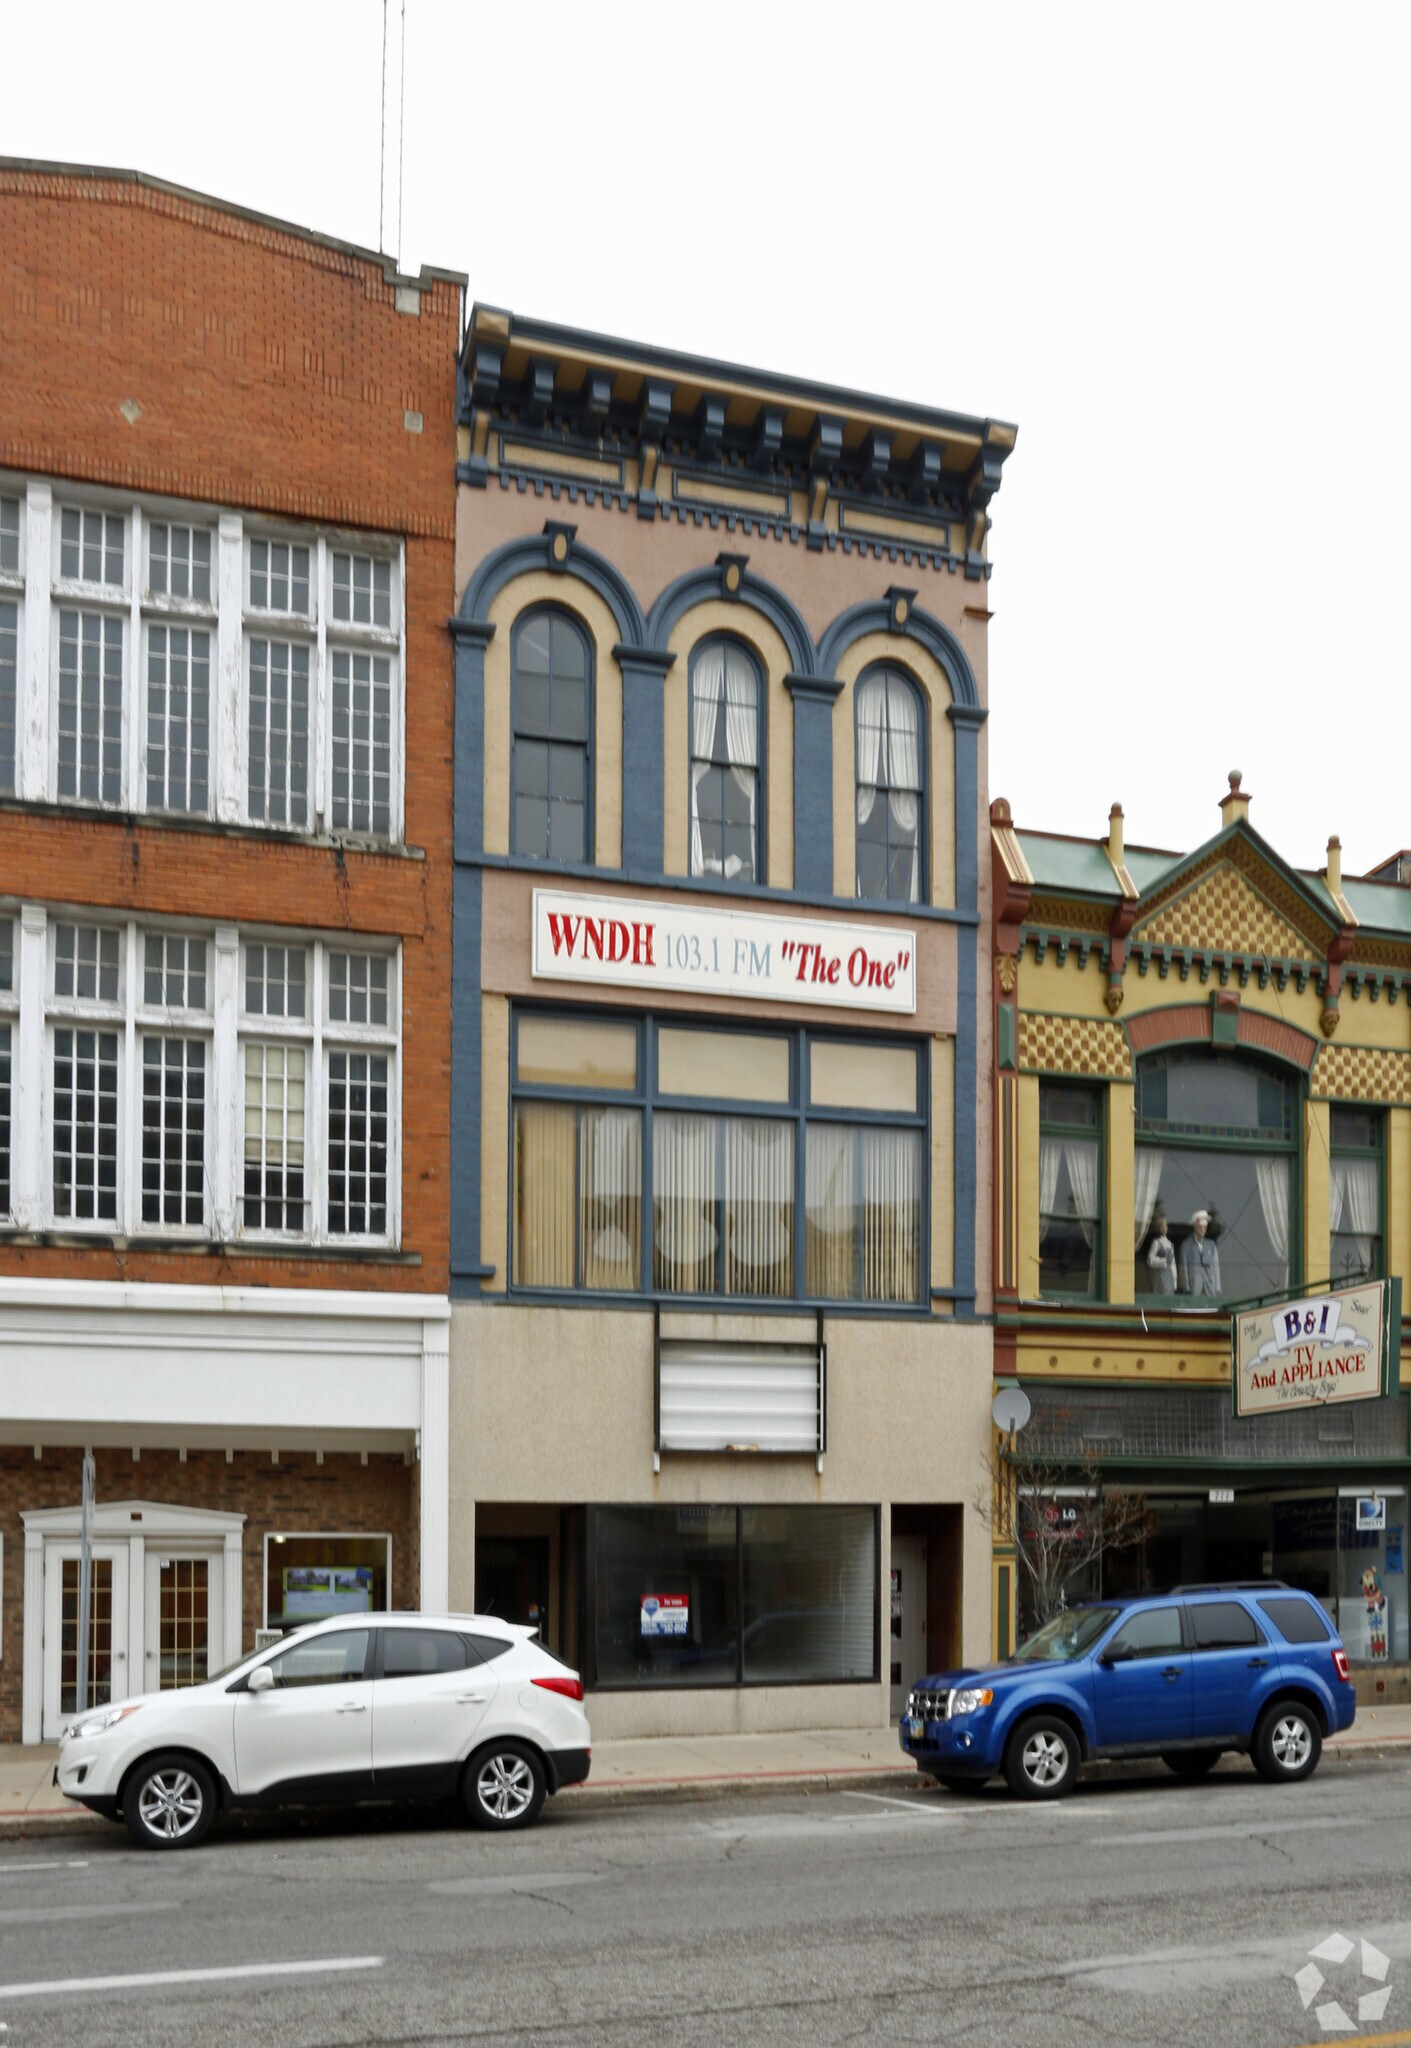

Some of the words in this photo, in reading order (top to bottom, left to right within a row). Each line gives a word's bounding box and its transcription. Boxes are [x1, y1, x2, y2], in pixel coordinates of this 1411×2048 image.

[547, 912, 656, 967] WNDH
[665, 933, 721, 973] 103.1
[732, 938, 772, 978] FM
[781, 940, 841, 984] "The
[848, 947, 911, 990] One"
[1284, 1304, 1330, 1341] B&I
[1250, 1369, 1276, 1390] And
[1280, 1352, 1366, 1386] APPLIANCE
[1294, 1344, 1316, 1365] TV
